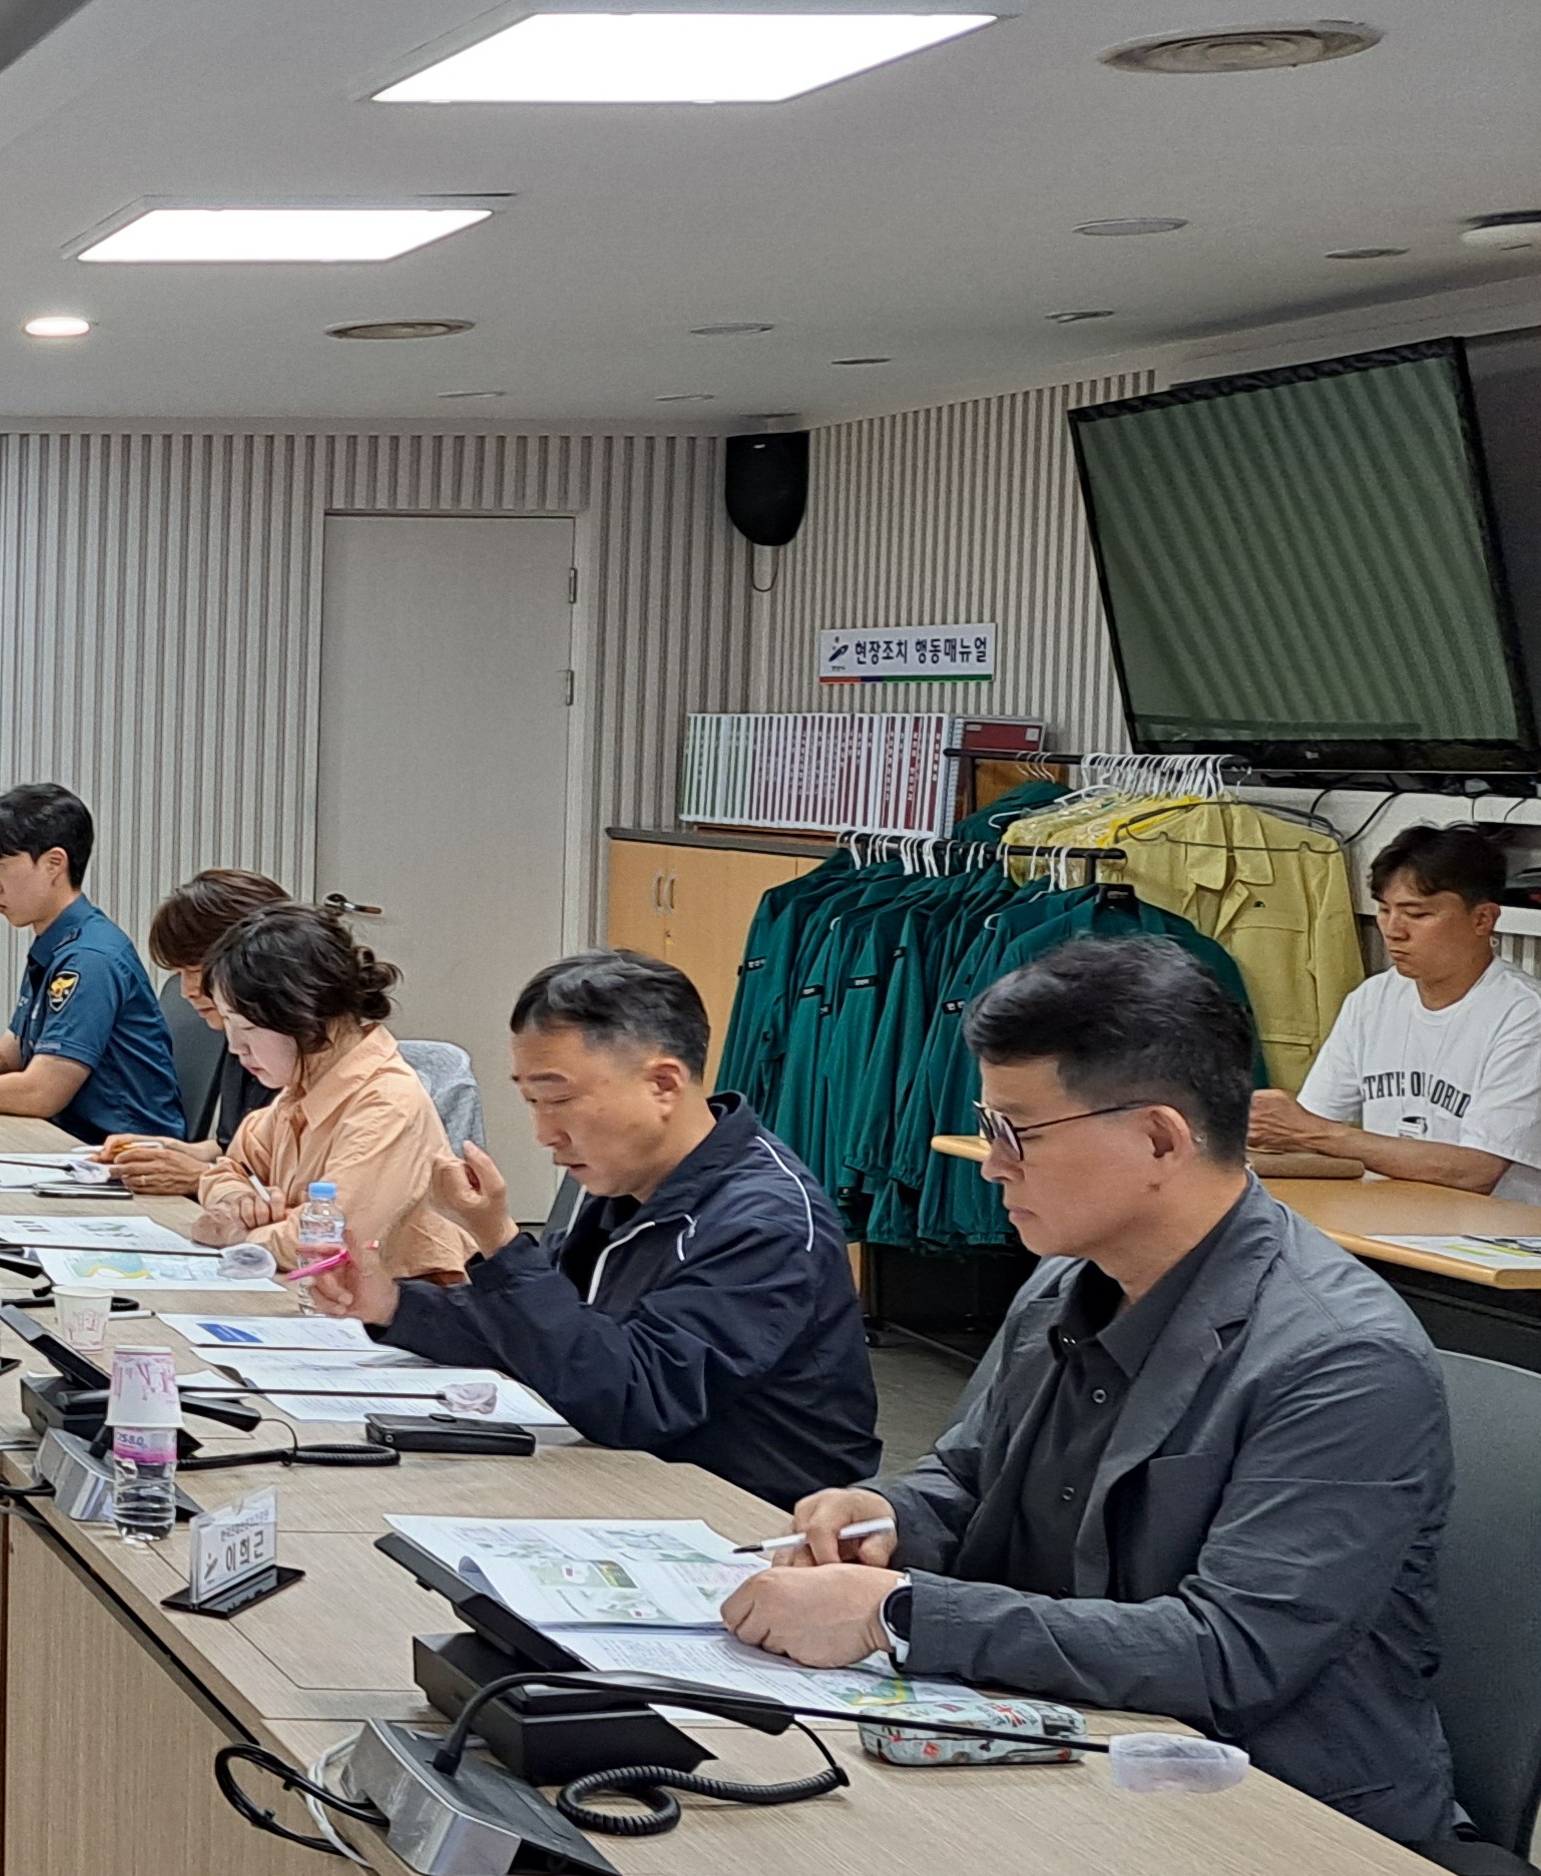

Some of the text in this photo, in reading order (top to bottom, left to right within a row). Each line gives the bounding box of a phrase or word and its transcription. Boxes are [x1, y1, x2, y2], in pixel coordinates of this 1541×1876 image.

[854, 636, 987, 666] 현장조치 행동매뉴얼
[1362, 1071, 1406, 1101] TATE
